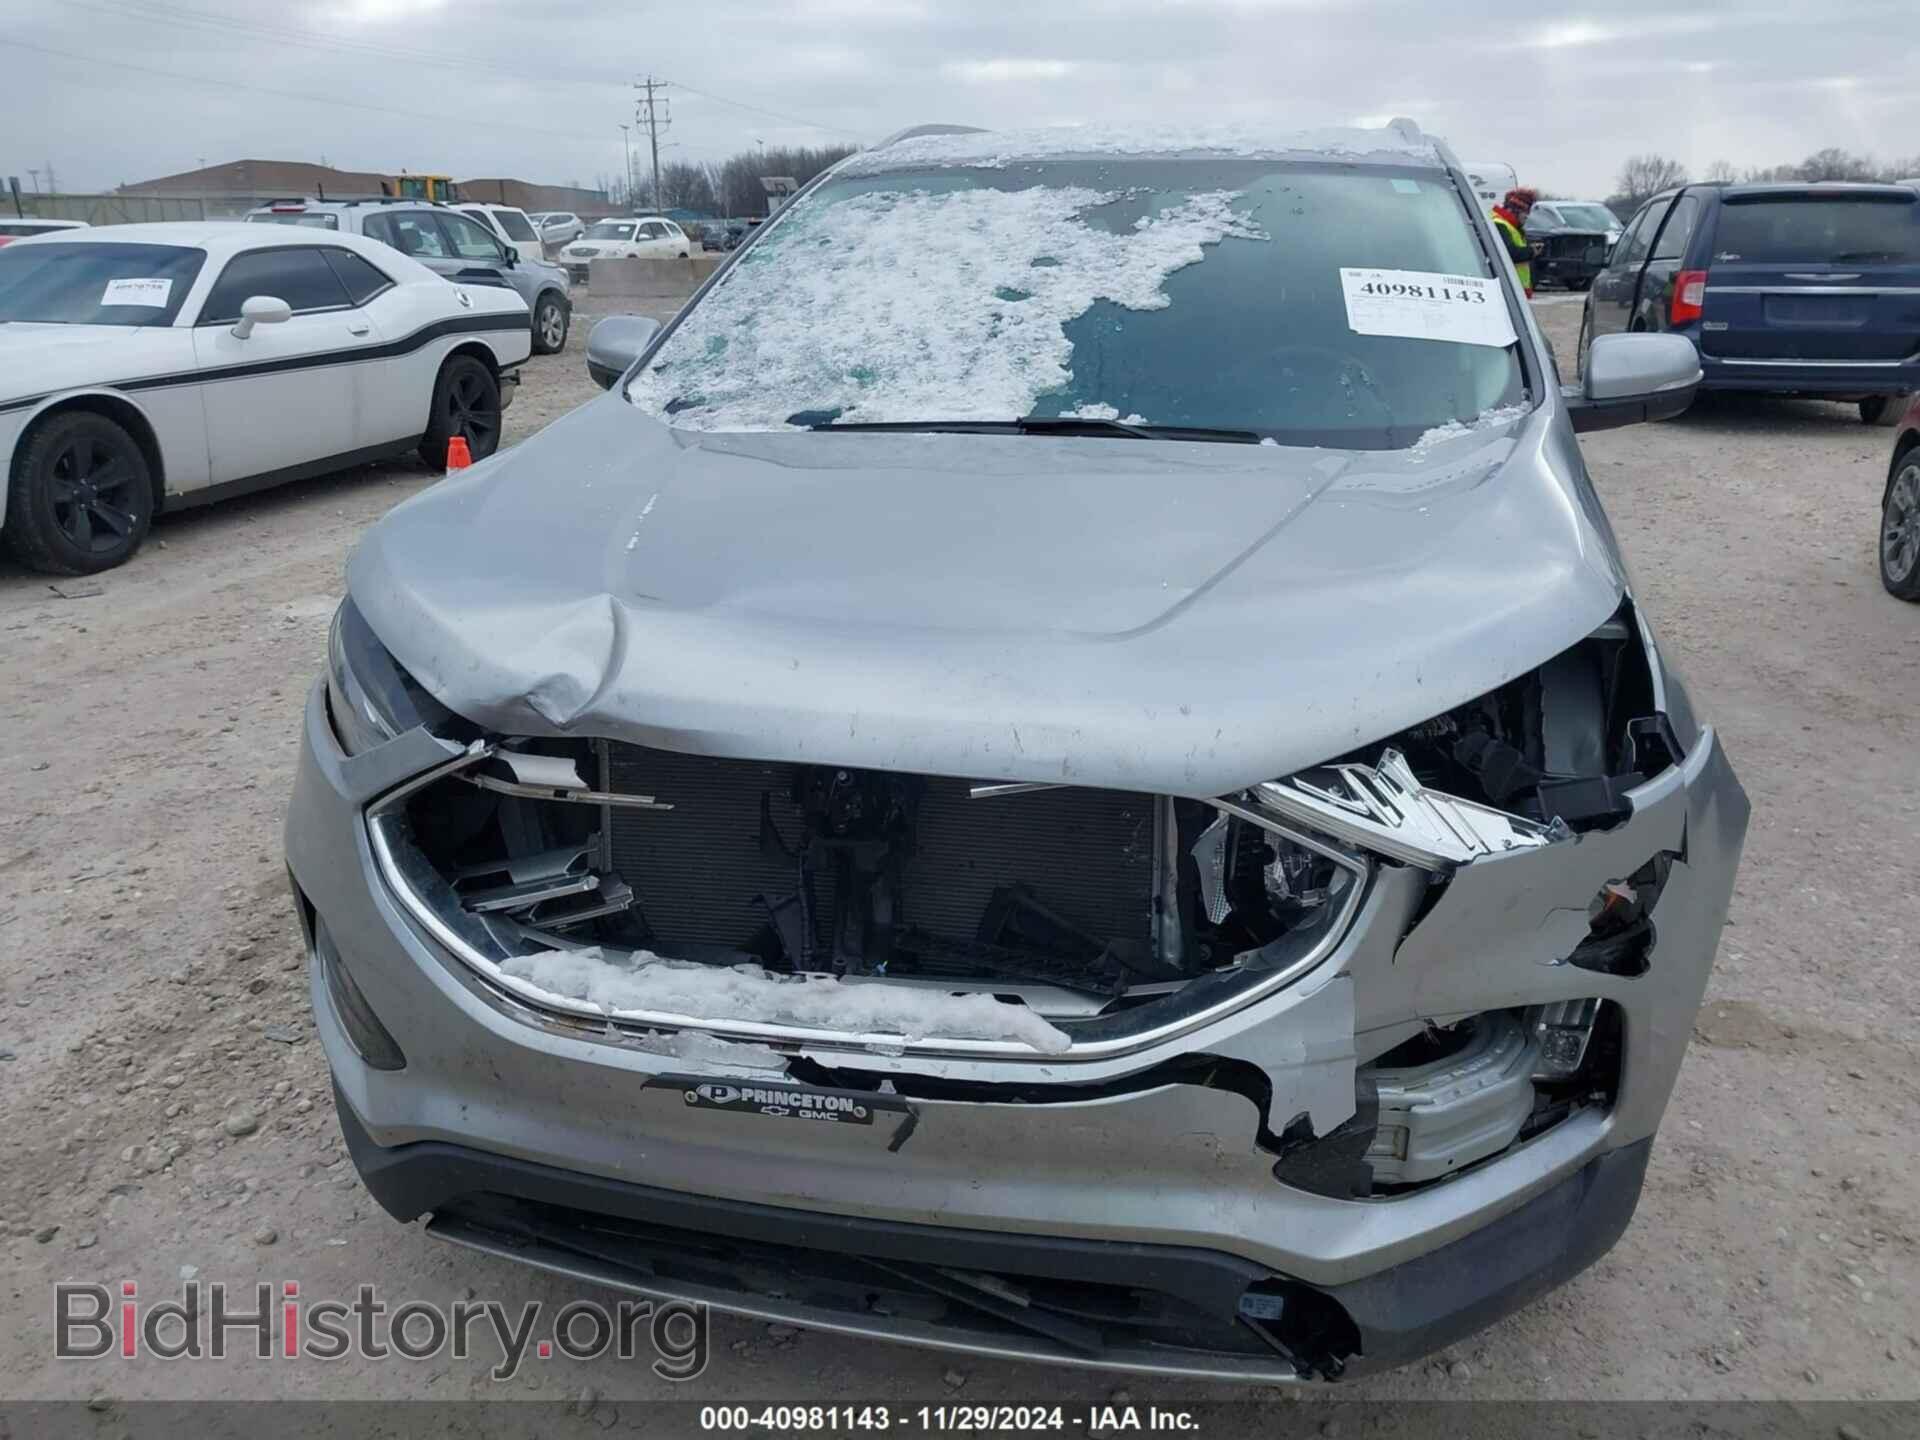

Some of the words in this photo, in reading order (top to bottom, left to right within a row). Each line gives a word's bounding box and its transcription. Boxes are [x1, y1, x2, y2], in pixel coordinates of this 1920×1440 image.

[1361, 282, 1486, 304] 40981143
[741, 1088, 854, 1112] PRINCETON
[799, 1109, 839, 1121] GMC
